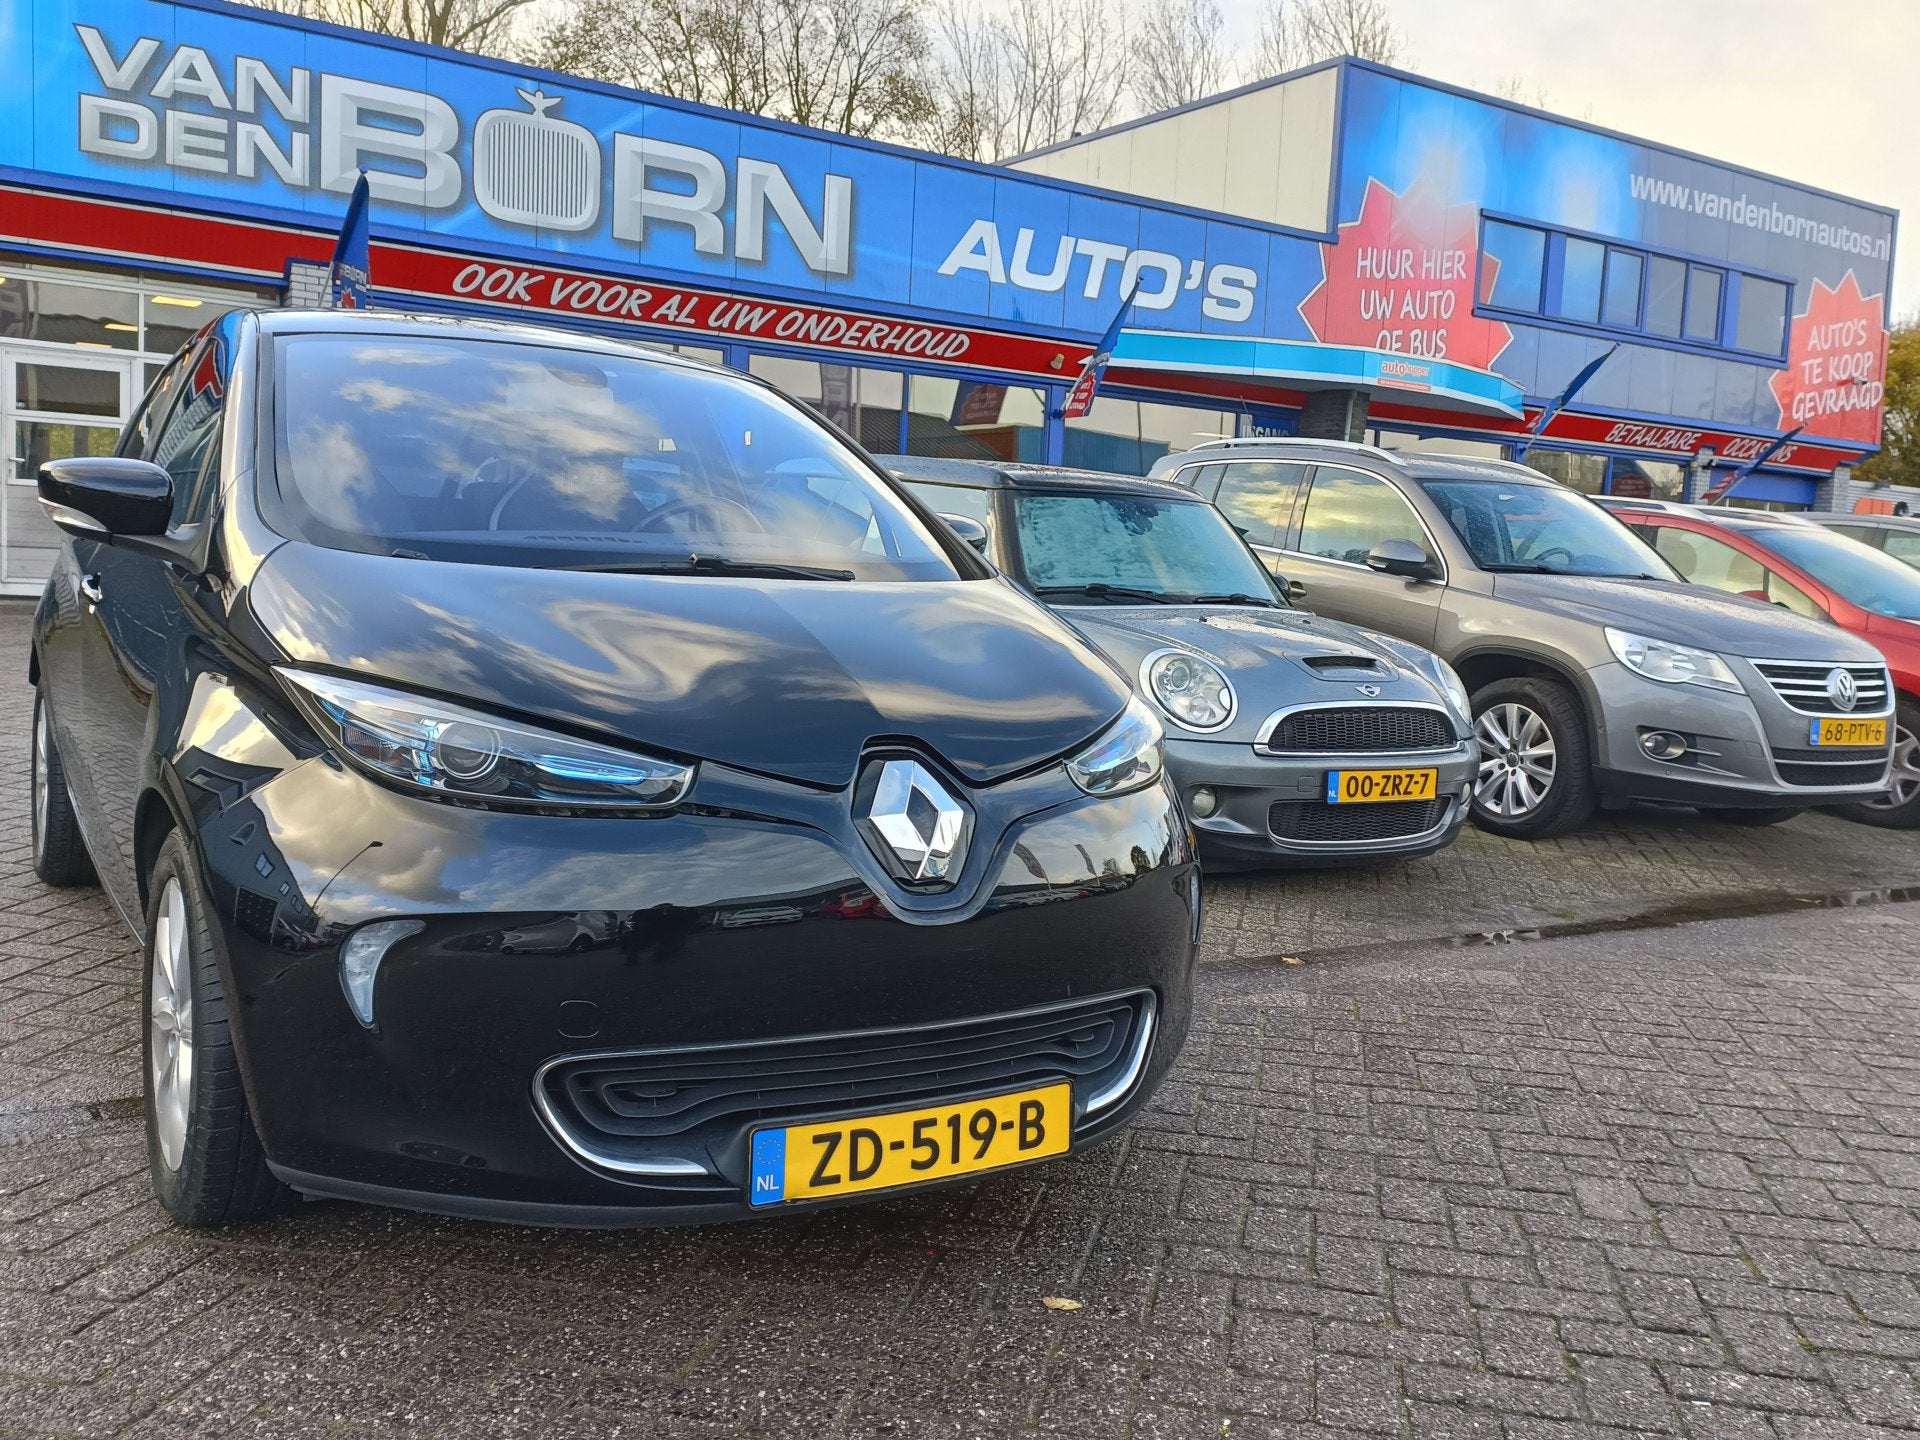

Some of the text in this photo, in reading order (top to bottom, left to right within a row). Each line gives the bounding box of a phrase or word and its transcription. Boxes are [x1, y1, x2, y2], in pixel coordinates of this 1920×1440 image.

[73, 22, 311, 124] VAN
[78, 92, 311, 187] DEN
[320, 72, 1258, 322] BORN AUTO'S
[1630, 173, 1891, 262] www.vandenbornautos.nl
[1356, 246, 1467, 280] HUUR HIER
[452, 263, 971, 358] OOK VOOR AL UW ONDERHOUD
[1360, 288, 1456, 321] UW AUTO
[1375, 328, 1448, 359] OF BUS
[1807, 319, 1867, 352] AUTO'S
[1801, 351, 1874, 385] TE KOOP
[1792, 381, 1884, 422] GEVRAAGD
[1604, 423, 1702, 451] BETAALBARE
[1825, 723, 1882, 742] 68-PTV-6
[1346, 773, 1430, 798] 00-ZRZ-7
[756, 1099, 1046, 1192] NL ZD-519-B
